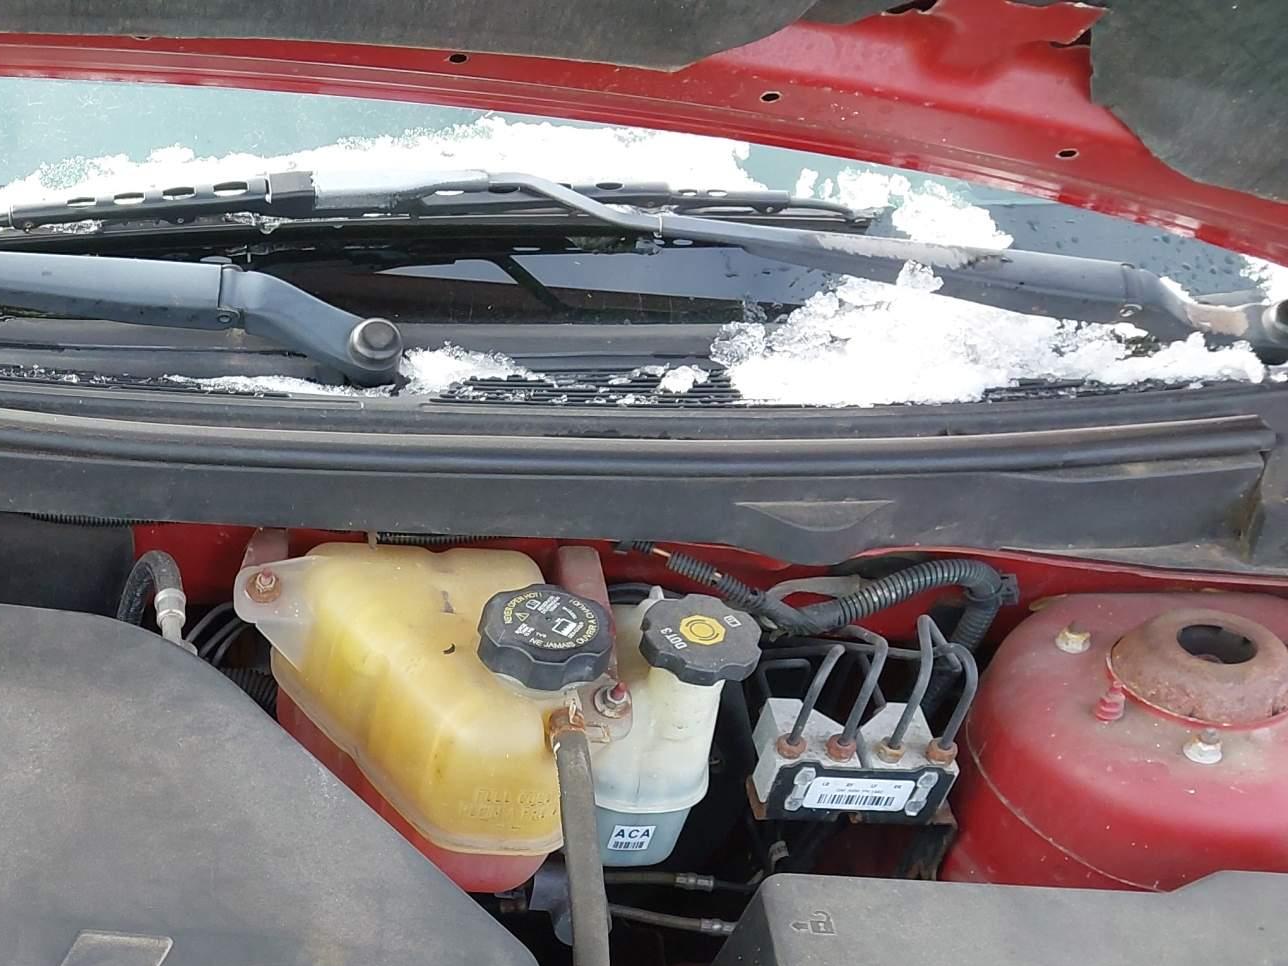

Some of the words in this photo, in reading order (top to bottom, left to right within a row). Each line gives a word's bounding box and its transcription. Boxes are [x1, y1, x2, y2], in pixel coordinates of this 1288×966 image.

[507, 595, 525, 608] OPEN
[529, 637, 544, 647] NE
[543, 641, 576, 649] JAMAIS
[614, 827, 652, 839] ACA
